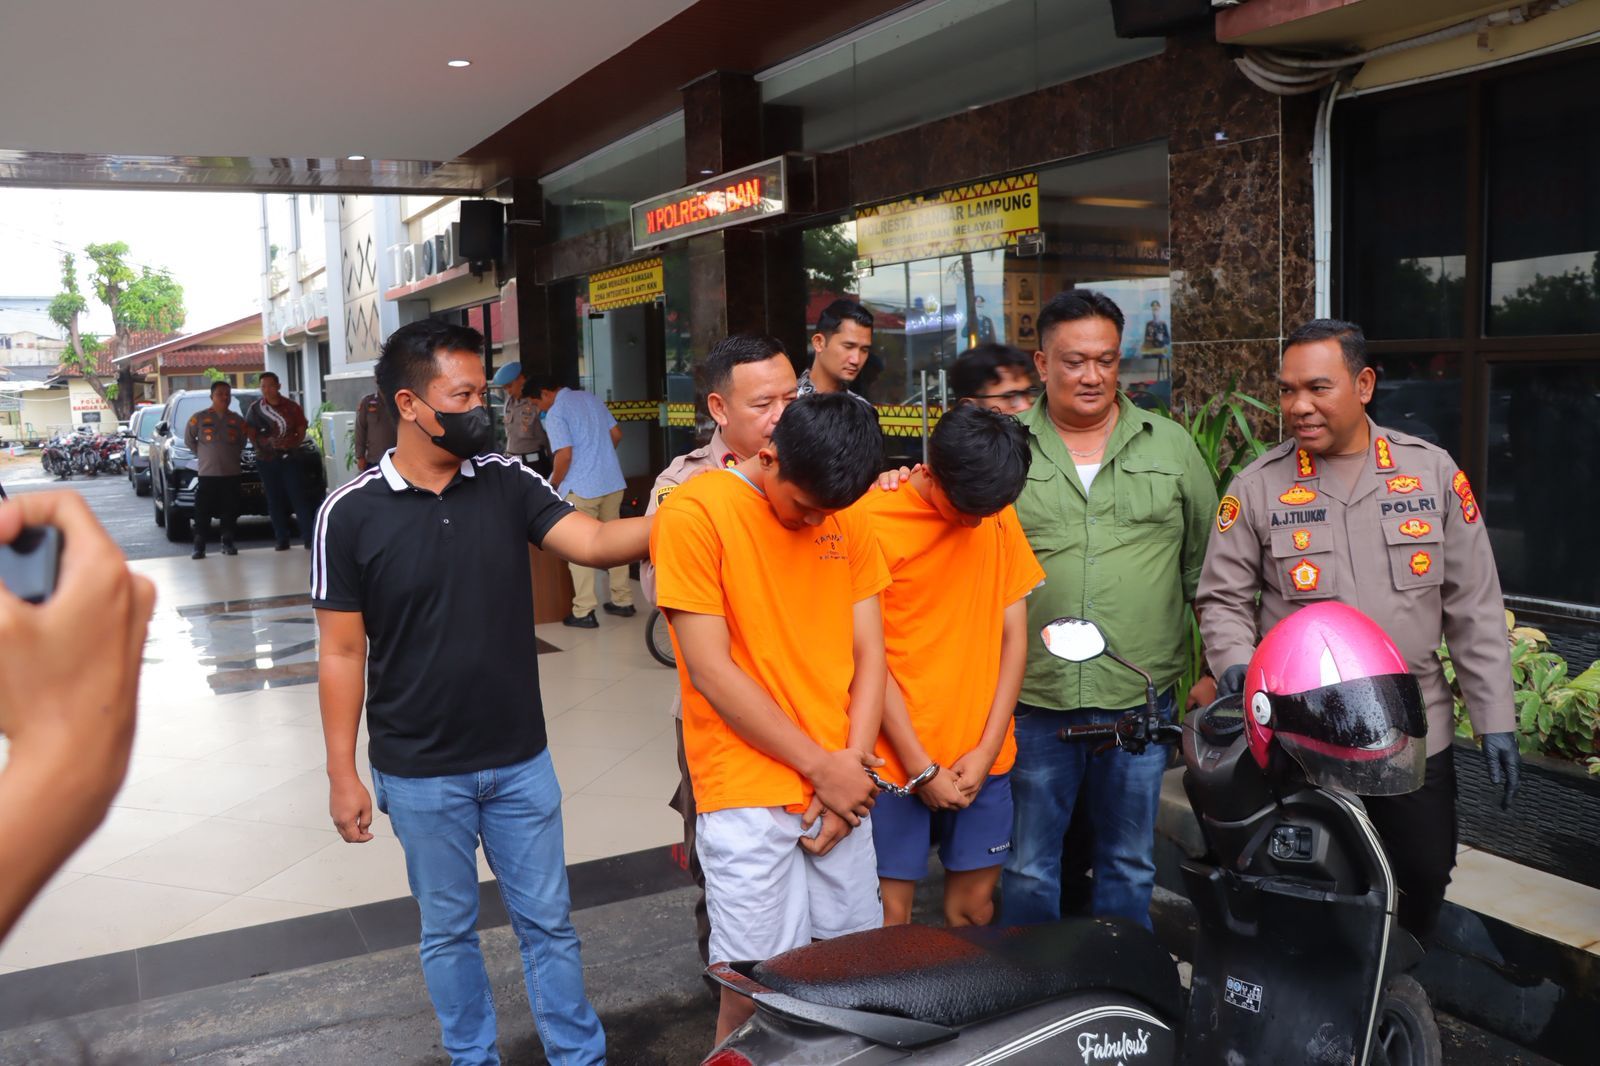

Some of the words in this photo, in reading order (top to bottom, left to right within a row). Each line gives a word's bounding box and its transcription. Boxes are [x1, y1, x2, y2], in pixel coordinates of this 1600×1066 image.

[726, 178, 761, 213] BAN
[861, 216, 914, 237] POLRESTA
[916, 205, 964, 228] BANDAR
[967, 193, 1032, 218] LAMPUNG
[930, 226, 950, 240] DAN
[953, 219, 1004, 236] MELAYANI
[1381, 497, 1437, 516] POLRI
[1077, 1028, 1151, 1065] Fabulous
